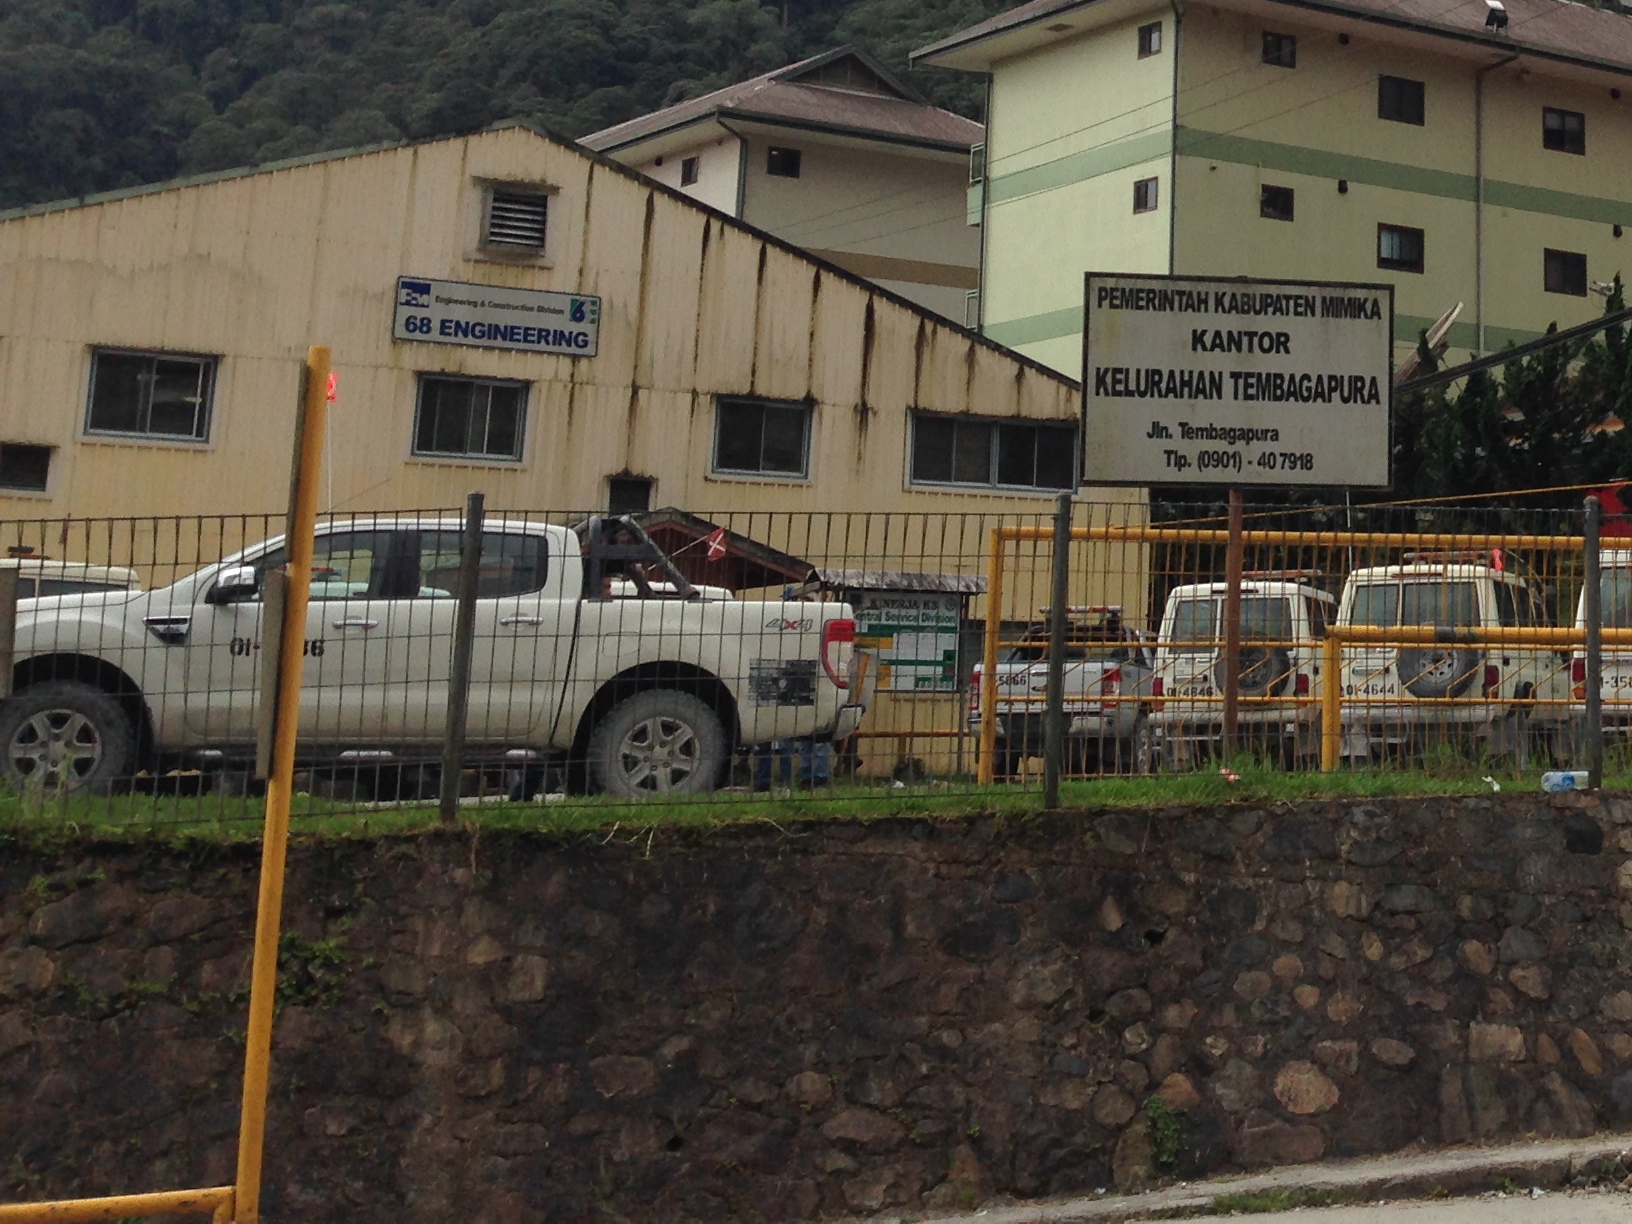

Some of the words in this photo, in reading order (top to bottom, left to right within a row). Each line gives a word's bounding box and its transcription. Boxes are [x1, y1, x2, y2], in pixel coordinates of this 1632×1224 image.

[435, 295, 478, 308] Engineering
[480, 300, 486, 308] &
[487, 300, 535, 312] Construction
[536, 305, 565, 315] Division
[1097, 286, 1210, 314] PEMERINTAH
[1214, 291, 1316, 318] KABUPATEN
[1320, 295, 1382, 320] MIMIKA
[404, 315, 432, 334] 68
[439, 319, 589, 349] ENGINEERING
[1191, 329, 1291, 355] KANTOR
[1094, 367, 1223, 400] KELURAHAN
[1229, 371, 1381, 405] TEMBAGAPURA
[1146, 421, 1174, 440] Jln.
[1178, 422, 1280, 446] Tembagapura
[1163, 449, 1192, 472] Tlp.
[1197, 450, 1242, 473] (0901)
[855, 611, 882, 622] entral
